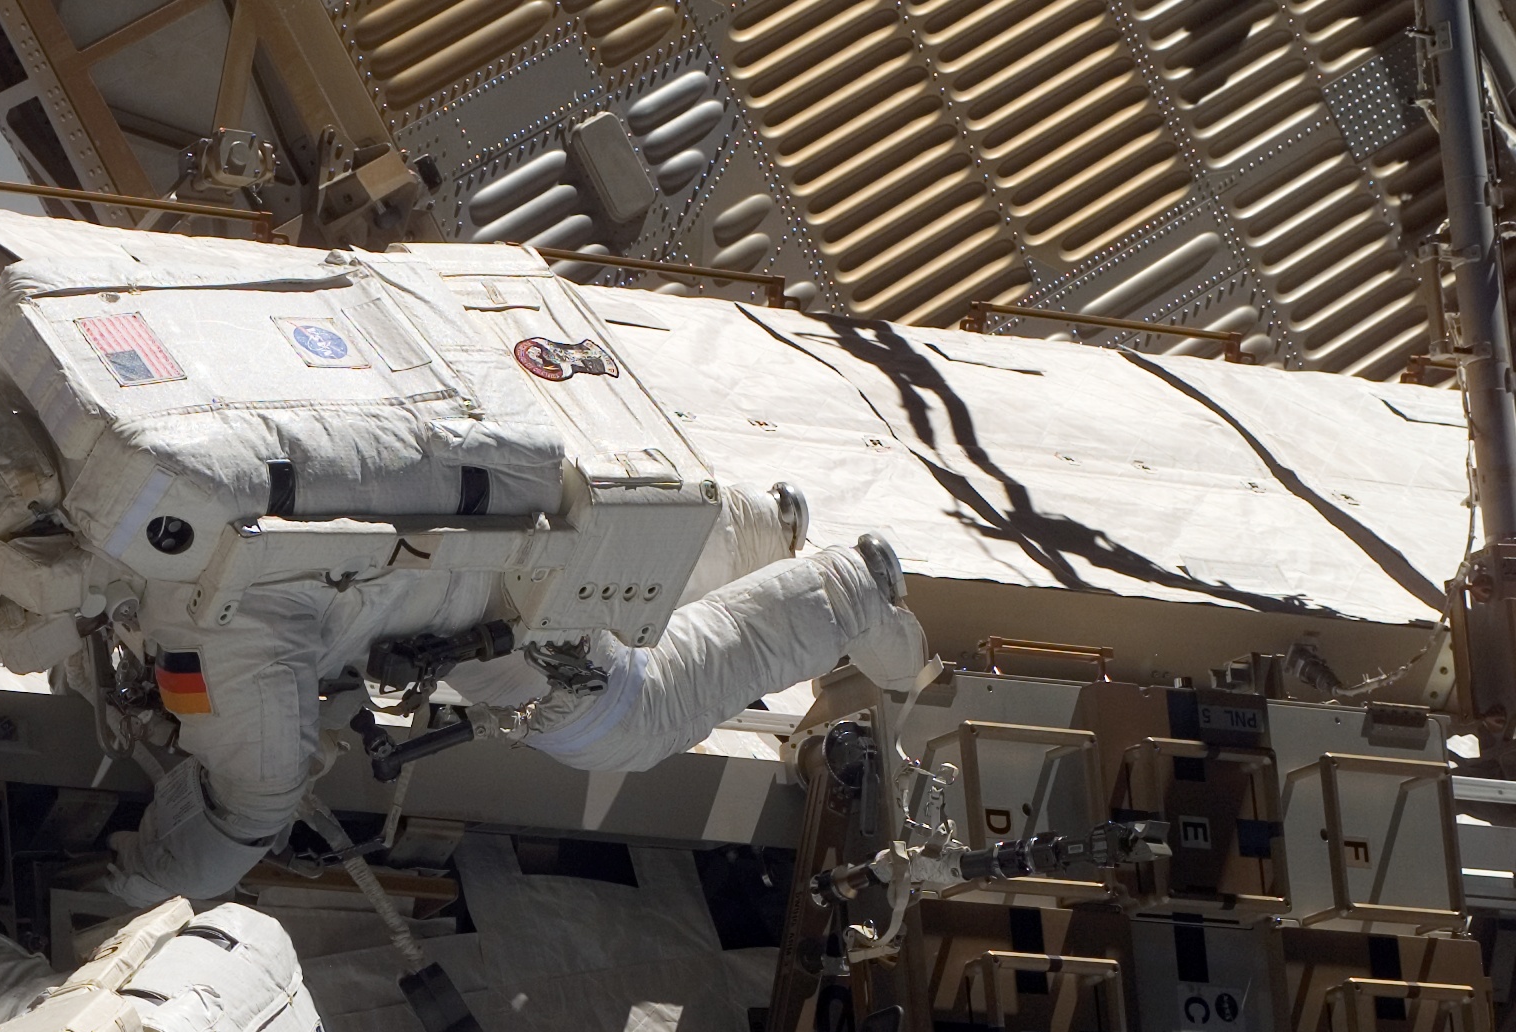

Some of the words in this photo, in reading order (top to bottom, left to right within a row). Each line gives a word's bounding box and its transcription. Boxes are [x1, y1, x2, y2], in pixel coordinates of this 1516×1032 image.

[1203, 710, 1211, 724] 5
[1225, 710, 1258, 730] PNL
[985, 809, 1011, 834] D
[1183, 821, 1209, 842] E
[1344, 840, 1370, 863] F
